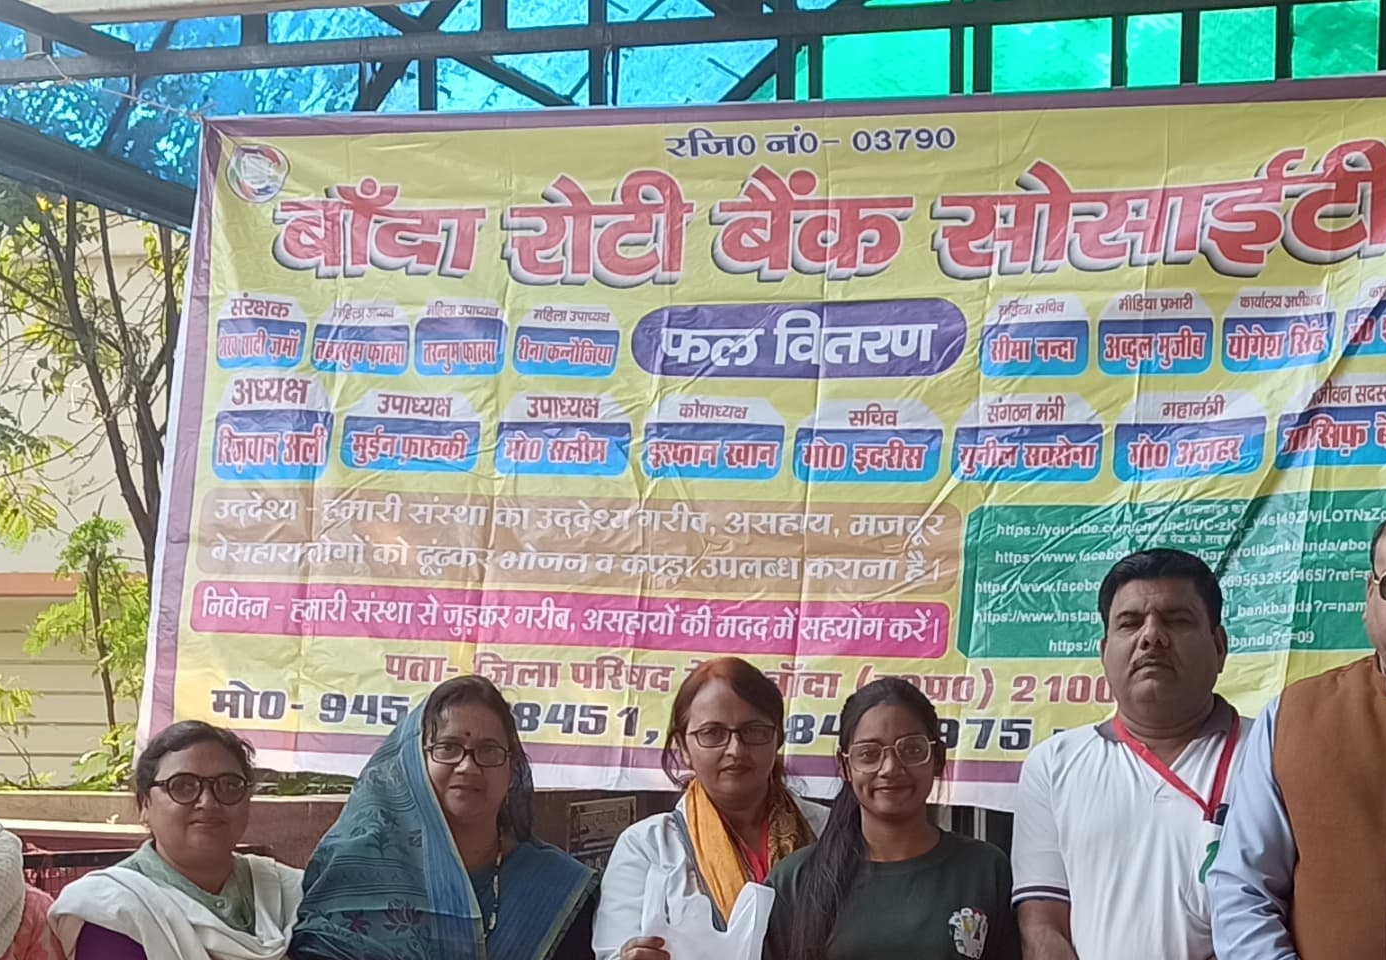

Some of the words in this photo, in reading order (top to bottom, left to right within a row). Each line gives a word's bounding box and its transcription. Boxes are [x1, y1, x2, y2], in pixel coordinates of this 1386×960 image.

[852, 128, 956, 152] 03790
[273, 177, 486, 278] बाँदा
[502, 168, 694, 288] रोटी
[710, 164, 913, 282] बैंक
[230, 292, 293, 318] संरक्षक
[1118, 293, 1159, 312] मीडिया
[1160, 292, 1193, 313] प्रभारी
[1239, 291, 1282, 310] कार्यालय
[533, 307, 567, 323] महिला
[569, 309, 610, 324] उपाध्यक्ष
[661, 327, 765, 366] फल
[773, 310, 939, 366] वितरण
[990, 333, 1032, 362] सीमा
[1227, 322, 1285, 360] योगेश
[232, 377, 312, 405] अध्यक्ष
[377, 393, 453, 418] उपाध्यक्ष
[526, 396, 600, 419] उपाध्यक्ष
[678, 399, 750, 420] कोषाध्यक्ष
[848, 402, 899, 427] सचिव
[987, 396, 1032, 424] संगठन
[1035, 395, 1066, 423] मंत्री
[1162, 394, 1225, 420] महामंत्री
[283, 423, 328, 466] अली
[351, 425, 398, 467] मुईन
[547, 430, 609, 464] सलीम
[724, 441, 779, 469] खान
[853, 437, 928, 474] इदरीस
[409, 495, 490, 526] संस्था
[494, 505, 531, 530] का
[372, 536, 412, 567] को
[499, 543, 589, 574] भोजन
[594, 554, 616, 575] व
[700, 552, 800, 582] उपलब्ध
[804, 556, 902, 582] कराना
[201, 585, 270, 620] निवेदन
[289, 586, 348, 624] हमारी
[350, 592, 415, 626] संस्था
[416, 593, 441, 627] से
[441, 601, 512, 637] जुड़कर
[584, 602, 679, 638] असहायों
[680, 604, 713, 638] की
[714, 613, 771, 641] मदद
[772, 606, 802, 641] में
[799, 606, 885, 643] सहयोग
[474, 651, 563, 689] जिला
[569, 654, 676, 692] परिषद
[1010, 674, 1116, 704] 2100
[317, 691, 660, 746] 9458451,
